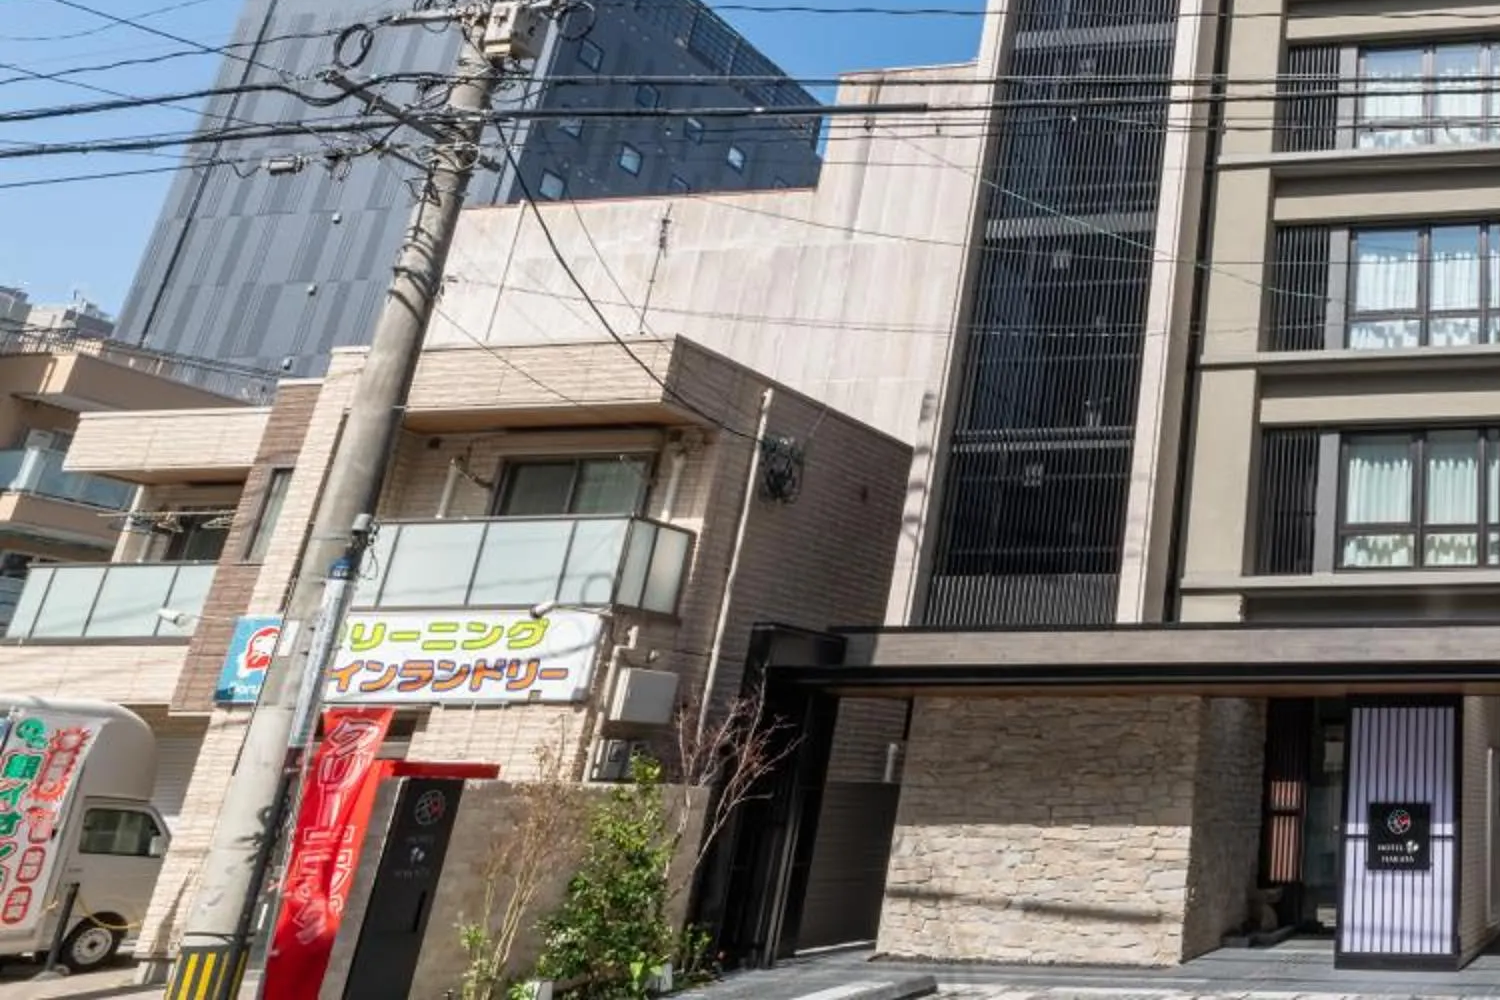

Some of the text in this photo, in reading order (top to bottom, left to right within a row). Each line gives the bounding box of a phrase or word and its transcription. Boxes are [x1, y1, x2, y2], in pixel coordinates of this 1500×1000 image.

[345, 617, 549, 650] リーニング
[326, 659, 568, 692] インランドリー
